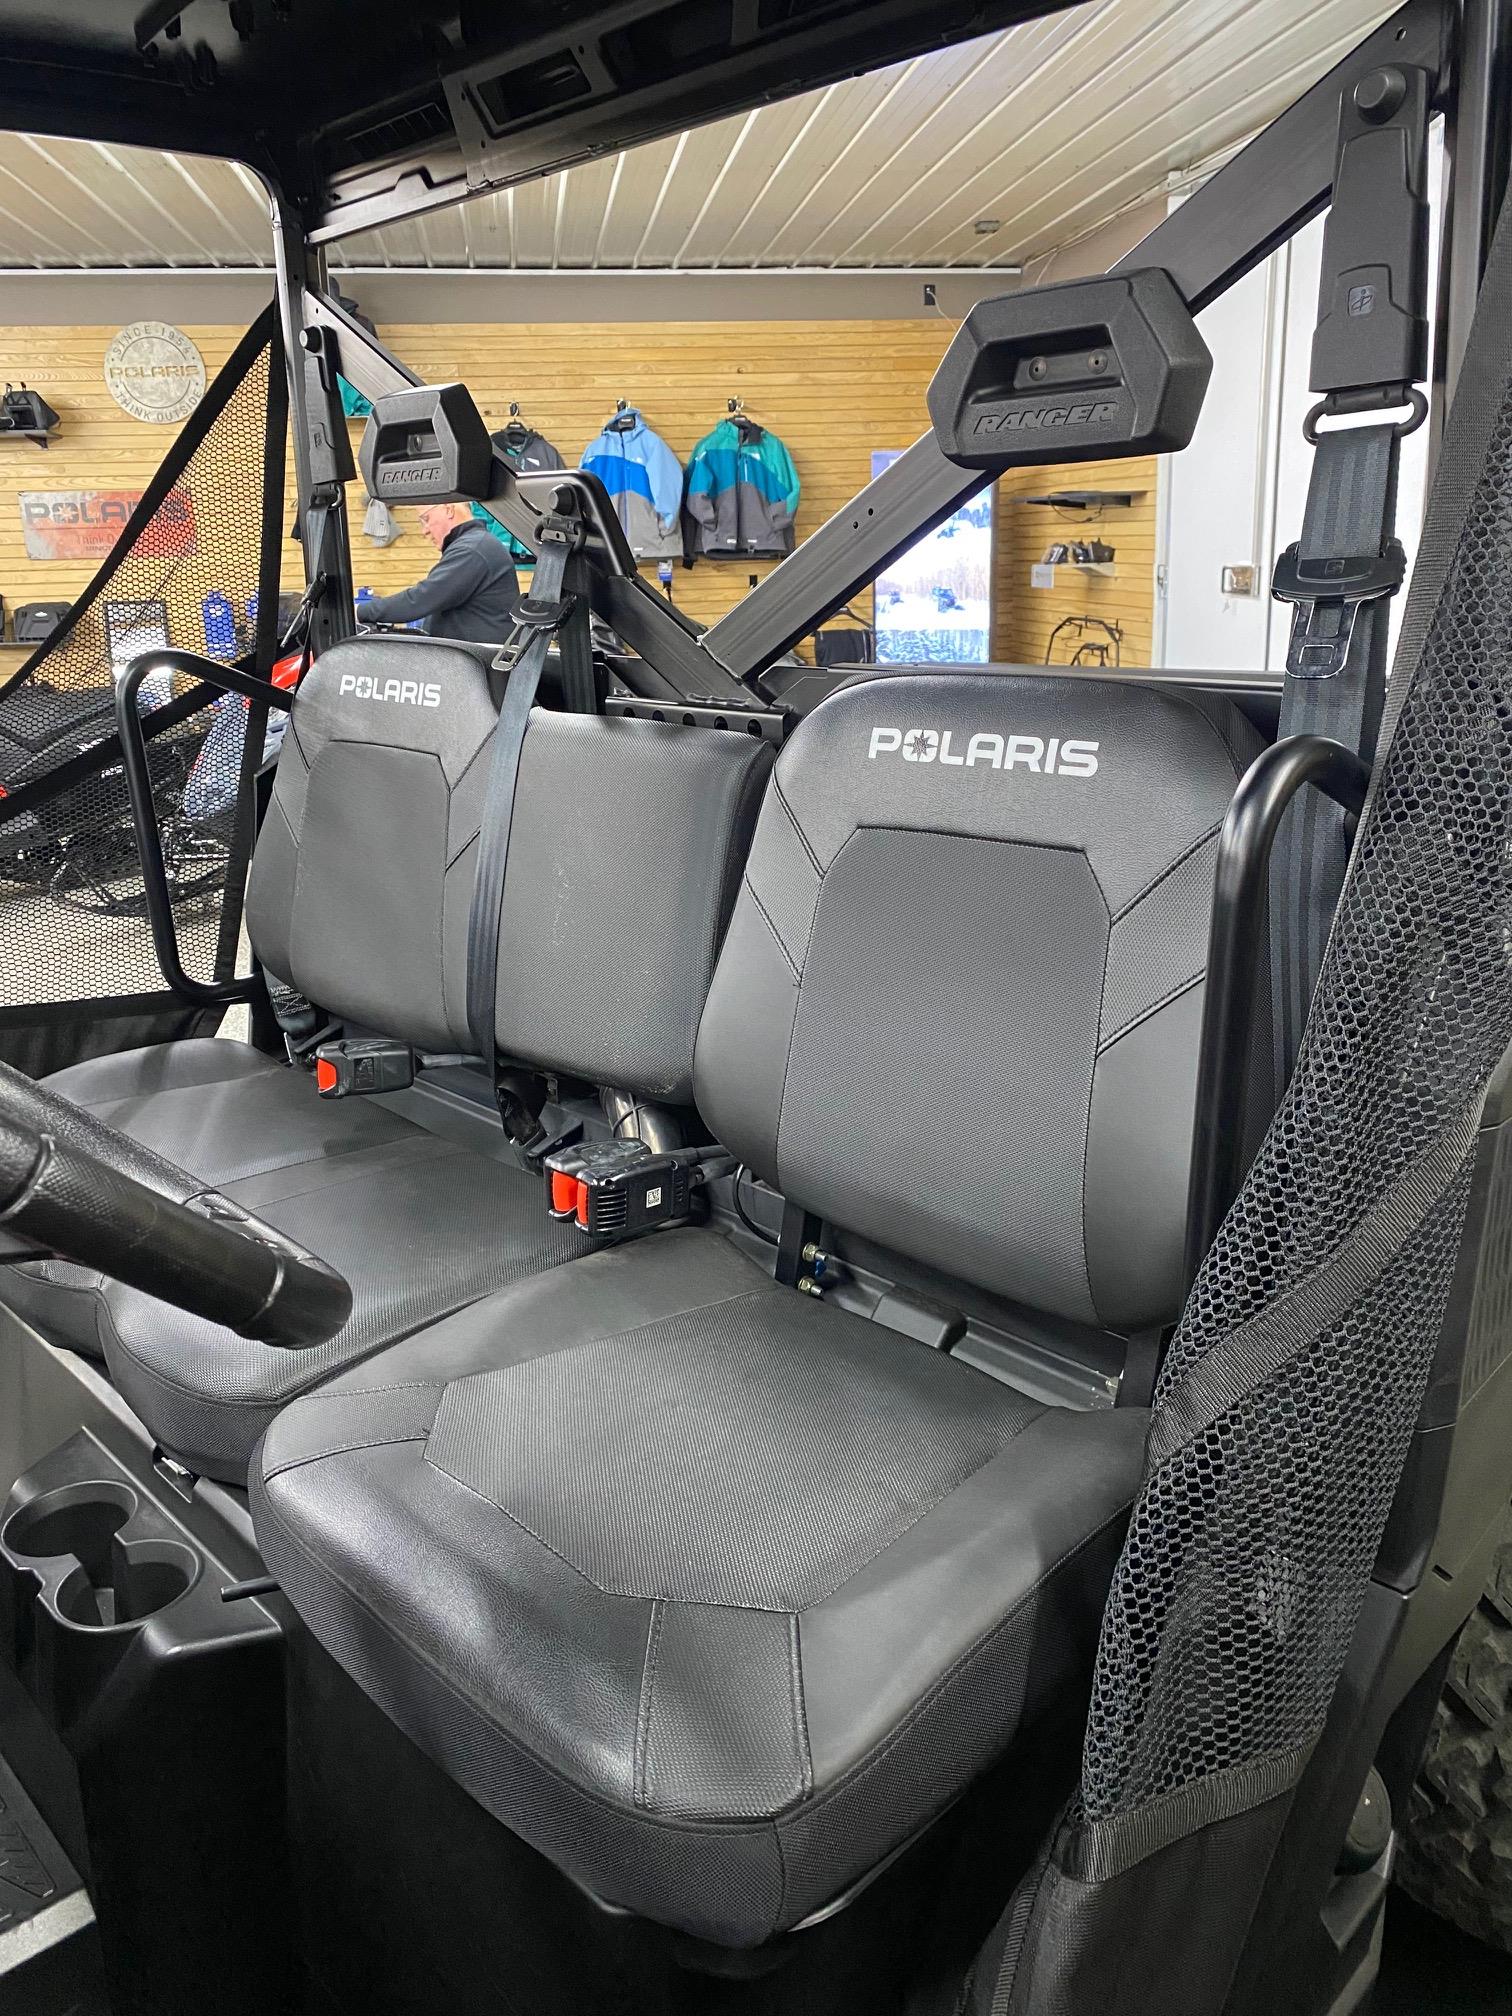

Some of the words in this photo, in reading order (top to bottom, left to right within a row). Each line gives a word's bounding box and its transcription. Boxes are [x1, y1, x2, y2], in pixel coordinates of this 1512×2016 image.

[112, 324, 152, 355] SINCE
[161, 327, 192, 354] 1954
[109, 364, 200, 379] POLARIS
[116, 391, 150, 420] THINK
[156, 389, 203, 422] OUTSIDE
[972, 401, 1119, 435] RANGER
[381, 466, 442, 485] RANGER
[339, 674, 442, 708] POLARIS
[868, 726, 1101, 778] POLARIS
